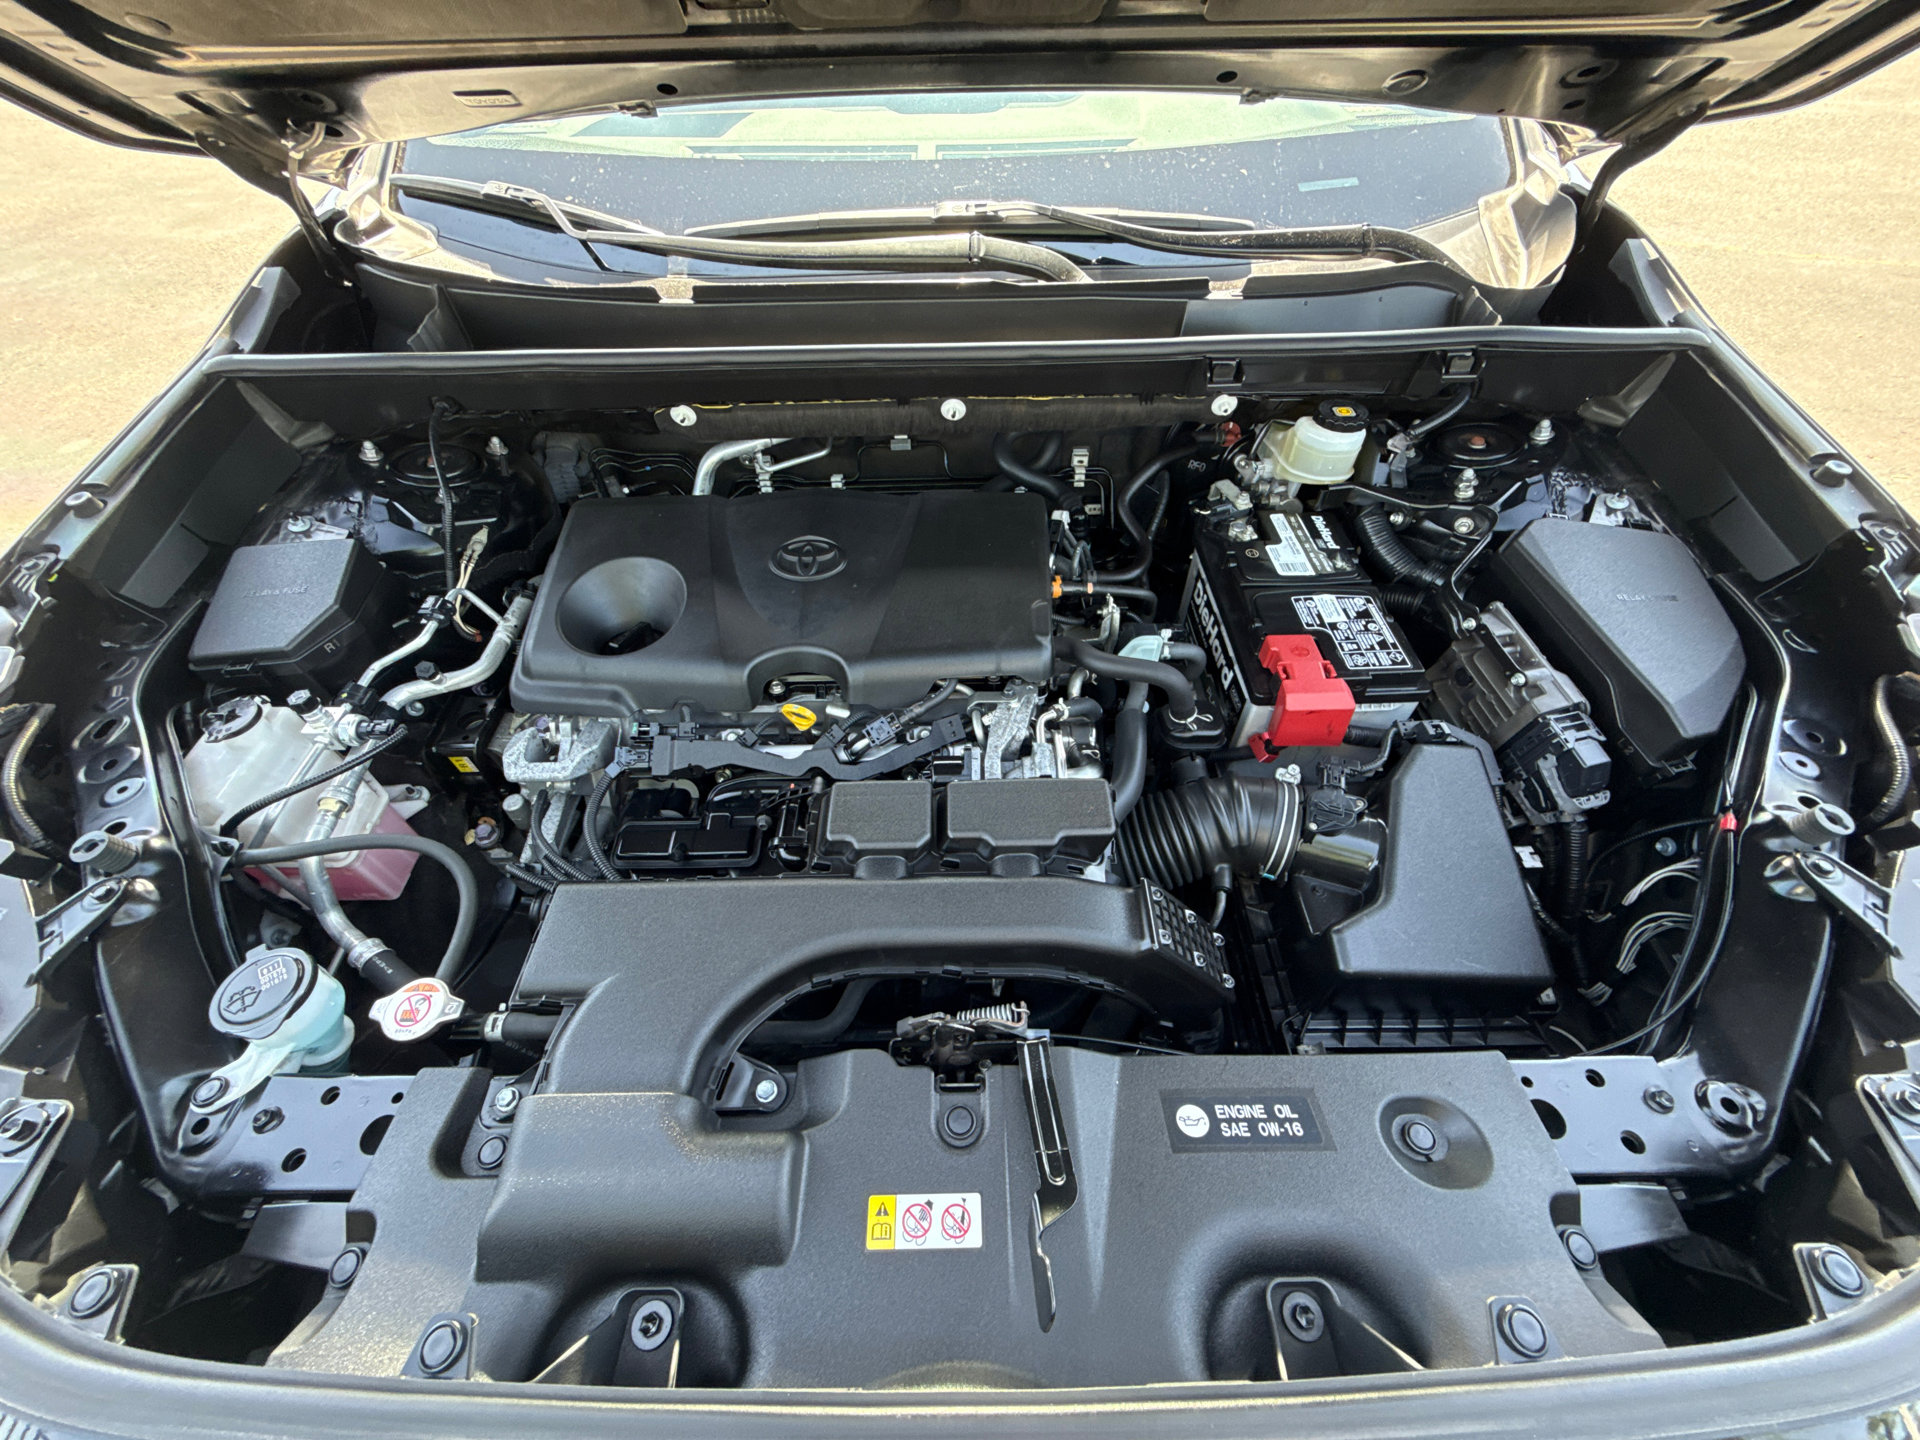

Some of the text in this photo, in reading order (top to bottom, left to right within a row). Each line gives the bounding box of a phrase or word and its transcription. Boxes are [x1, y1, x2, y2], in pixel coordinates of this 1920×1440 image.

[1310, 515, 1341, 549] DieHard
[282, 585, 310, 595] FUSE
[1616, 592, 1646, 601] RELAY
[1193, 579, 1234, 691] DieHard
[1214, 1104, 1299, 1119] ENGINE OIL
[1220, 1121, 1304, 1137] SAE 0W-16
